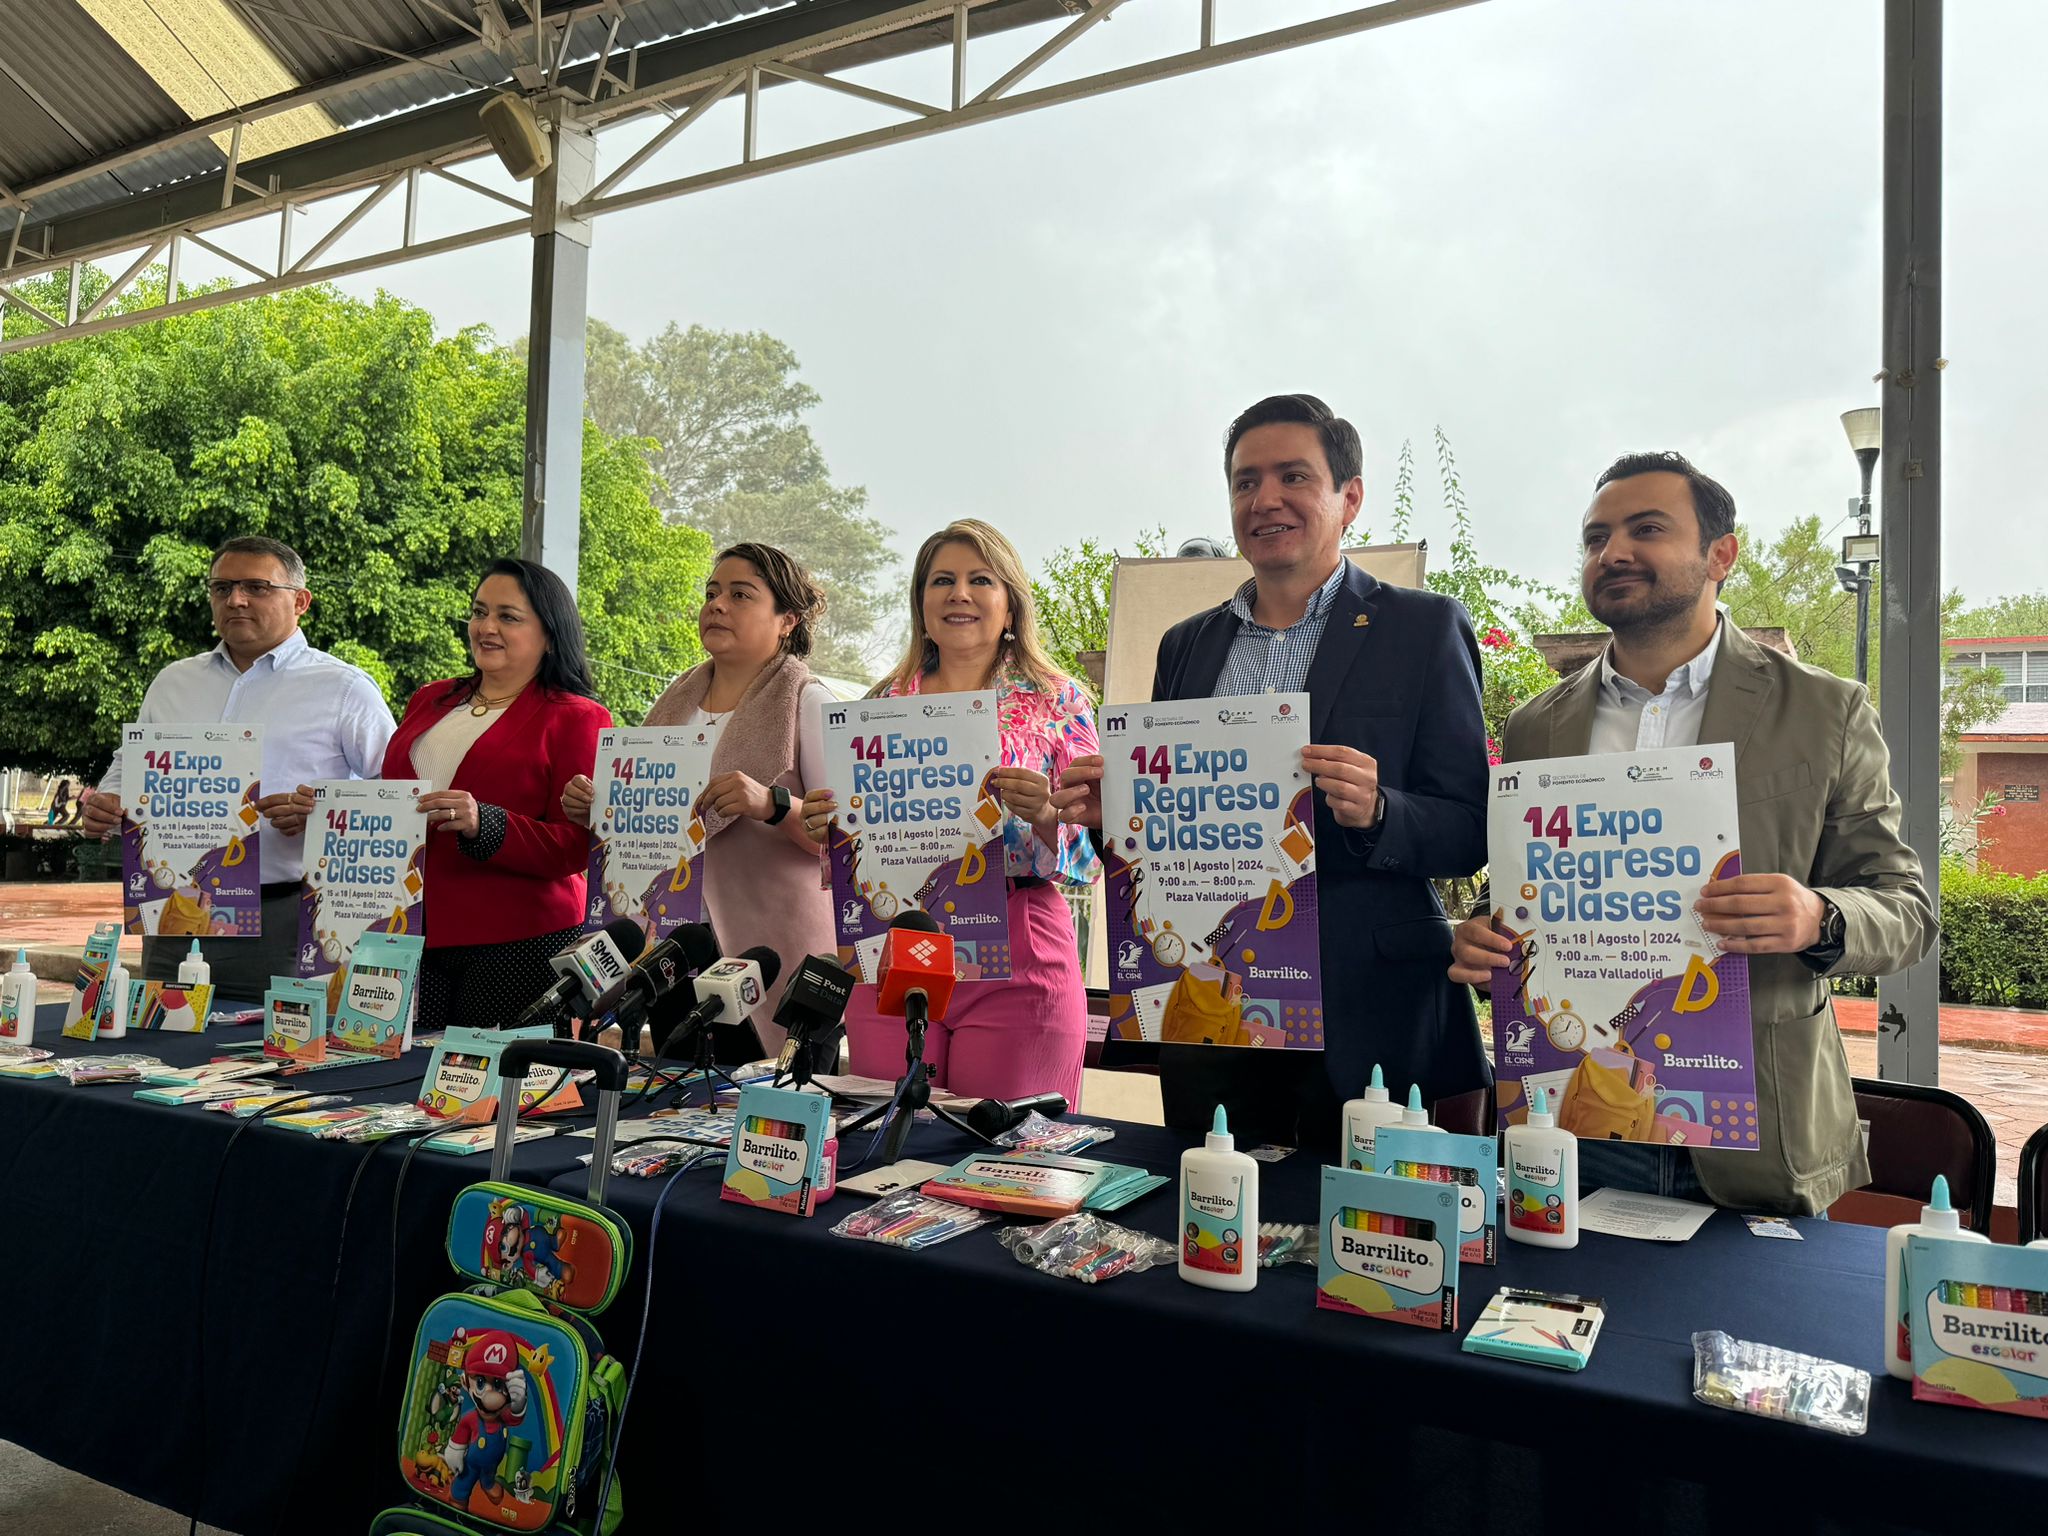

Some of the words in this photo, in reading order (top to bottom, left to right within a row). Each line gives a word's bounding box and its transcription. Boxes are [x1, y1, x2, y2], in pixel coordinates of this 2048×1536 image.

[850, 735, 884, 767] 14
[887, 733, 948, 764] Expo
[144, 751, 172, 775] 14
[174, 751, 222, 775] Expo
[611, 758, 634, 785] 14
[635, 757, 675, 785] Expo
[1130, 745, 1171, 784] 14
[1174, 743, 1247, 782] Expo
[853, 762, 974, 798] Regreso
[1690, 769, 1723, 778] Pumich
[144, 771, 240, 799] Regreso
[609, 780, 689, 812] Regreso
[1133, 778, 1279, 822] Regreso
[150, 794, 228, 818] Clases
[864, 793, 961, 825] Clases
[182, 823, 206, 831] Agosto
[326, 810, 348, 836] 14
[349, 810, 392, 837] Expo
[614, 807, 679, 835] Clases
[1523, 805, 1572, 848] 14
[1576, 803, 1662, 844] Expo
[868, 832, 876, 840] 15
[887, 831, 897, 840] 18
[904, 830, 933, 839] Agosto
[939, 828, 961, 836] 2024
[1132, 820, 1140, 828] a
[1146, 815, 1263, 852] Clases
[323, 832, 408, 864] Regreso
[615, 840, 621, 848] 15
[639, 841, 659, 849] Agosto
[875, 845, 893, 853] 9:00
[920, 842, 938, 850] 8:00
[622, 862, 638, 870] Plaza
[639, 863, 667, 871] Valladolid
[881, 857, 904, 866] Plaza
[906, 854, 949, 865] Valladolid
[1151, 862, 1160, 871] 15
[1174, 861, 1185, 870] 18
[1193, 862, 1229, 872] Agosto
[1237, 860, 1263, 870] 2024
[1526, 842, 1700, 890] Regreso
[327, 860, 395, 884] Clases
[1158, 878, 1180, 886] 9:00
[1213, 876, 1236, 886] 8:00
[216, 888, 255, 896] Barrilito.
[1166, 892, 1194, 902] Plaza
[1196, 892, 1249, 902] Valladolid
[1524, 887, 1534, 896] a
[1540, 882, 1681, 923] Clases
[950, 914, 1001, 925] Barrilito.
[1545, 934, 1557, 944] 15
[1573, 934, 1586, 944] 18
[1597, 934, 1640, 947] Agosto
[1650, 933, 1681, 944] 2024
[590, 940, 624, 979] SMRTV
[1555, 951, 1580, 961] 9:00
[1621, 951, 1648, 961] 8:00
[1249, 967, 1312, 980] Barrilito.
[1564, 968, 1597, 979] Plaza
[1599, 968, 1663, 979] Valladolid
[823, 979, 846, 996] Post
[1505, 1056, 1512, 1064] EL
[1514, 1056, 1535, 1065] CISNE
[1664, 1053, 1743, 1070] Barrilito.
[753, 1160, 784, 1172] escolar
[800, 1182, 809, 1209] Modelar
[1362, 1262, 1412, 1278] escolar
[1444, 1292, 1452, 1325] Modelar
[1971, 1343, 2036, 1362] escolar
